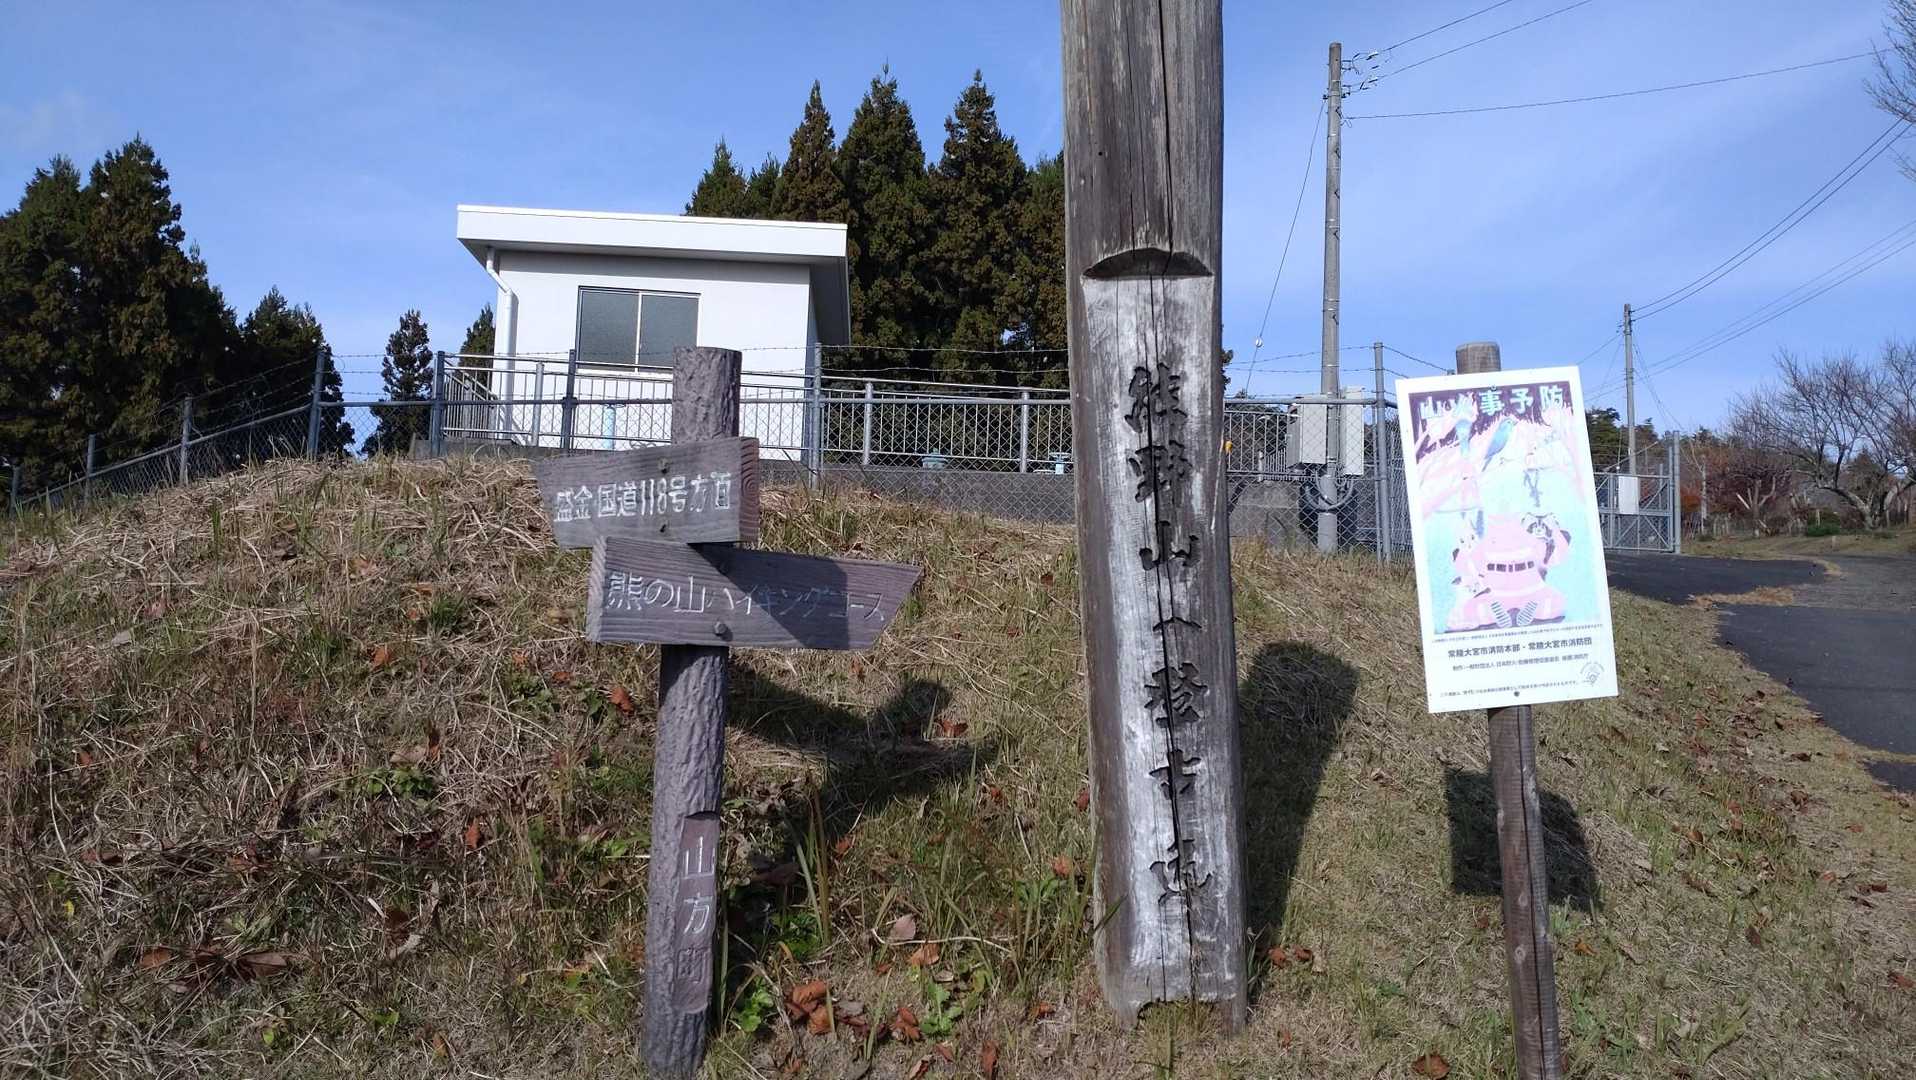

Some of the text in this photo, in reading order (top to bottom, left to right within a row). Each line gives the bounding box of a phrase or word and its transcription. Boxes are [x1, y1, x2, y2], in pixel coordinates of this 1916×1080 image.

[1420, 384, 1564, 420] 山火事予防
[553, 471, 732, 522] 盛金国道118号方面
[605, 571, 885, 621] 熊の山ハイキングコース
